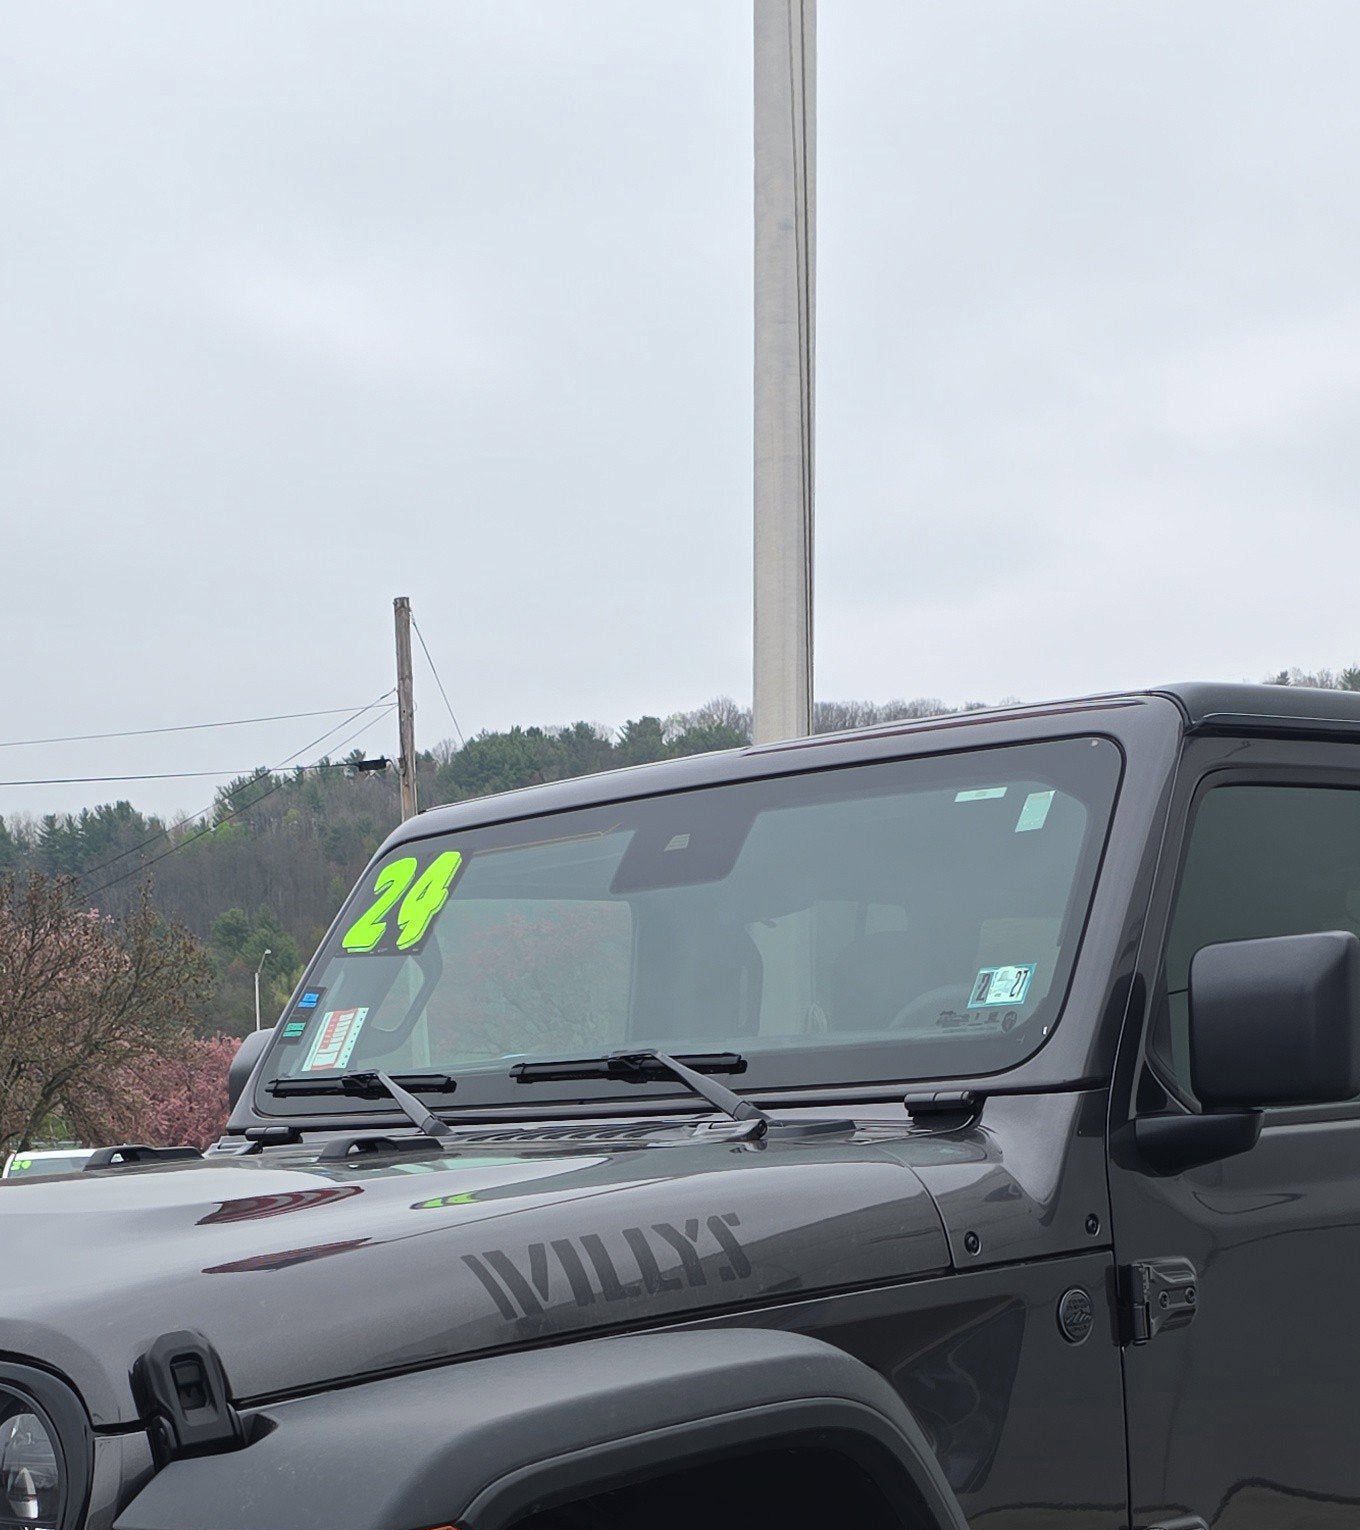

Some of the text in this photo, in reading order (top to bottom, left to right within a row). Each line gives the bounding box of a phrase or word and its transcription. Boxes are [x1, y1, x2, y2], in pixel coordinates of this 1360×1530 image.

[342, 851, 462, 953] 24
[1008, 969, 1030, 999] 27
[461, 1212, 751, 1321] WILLYS
